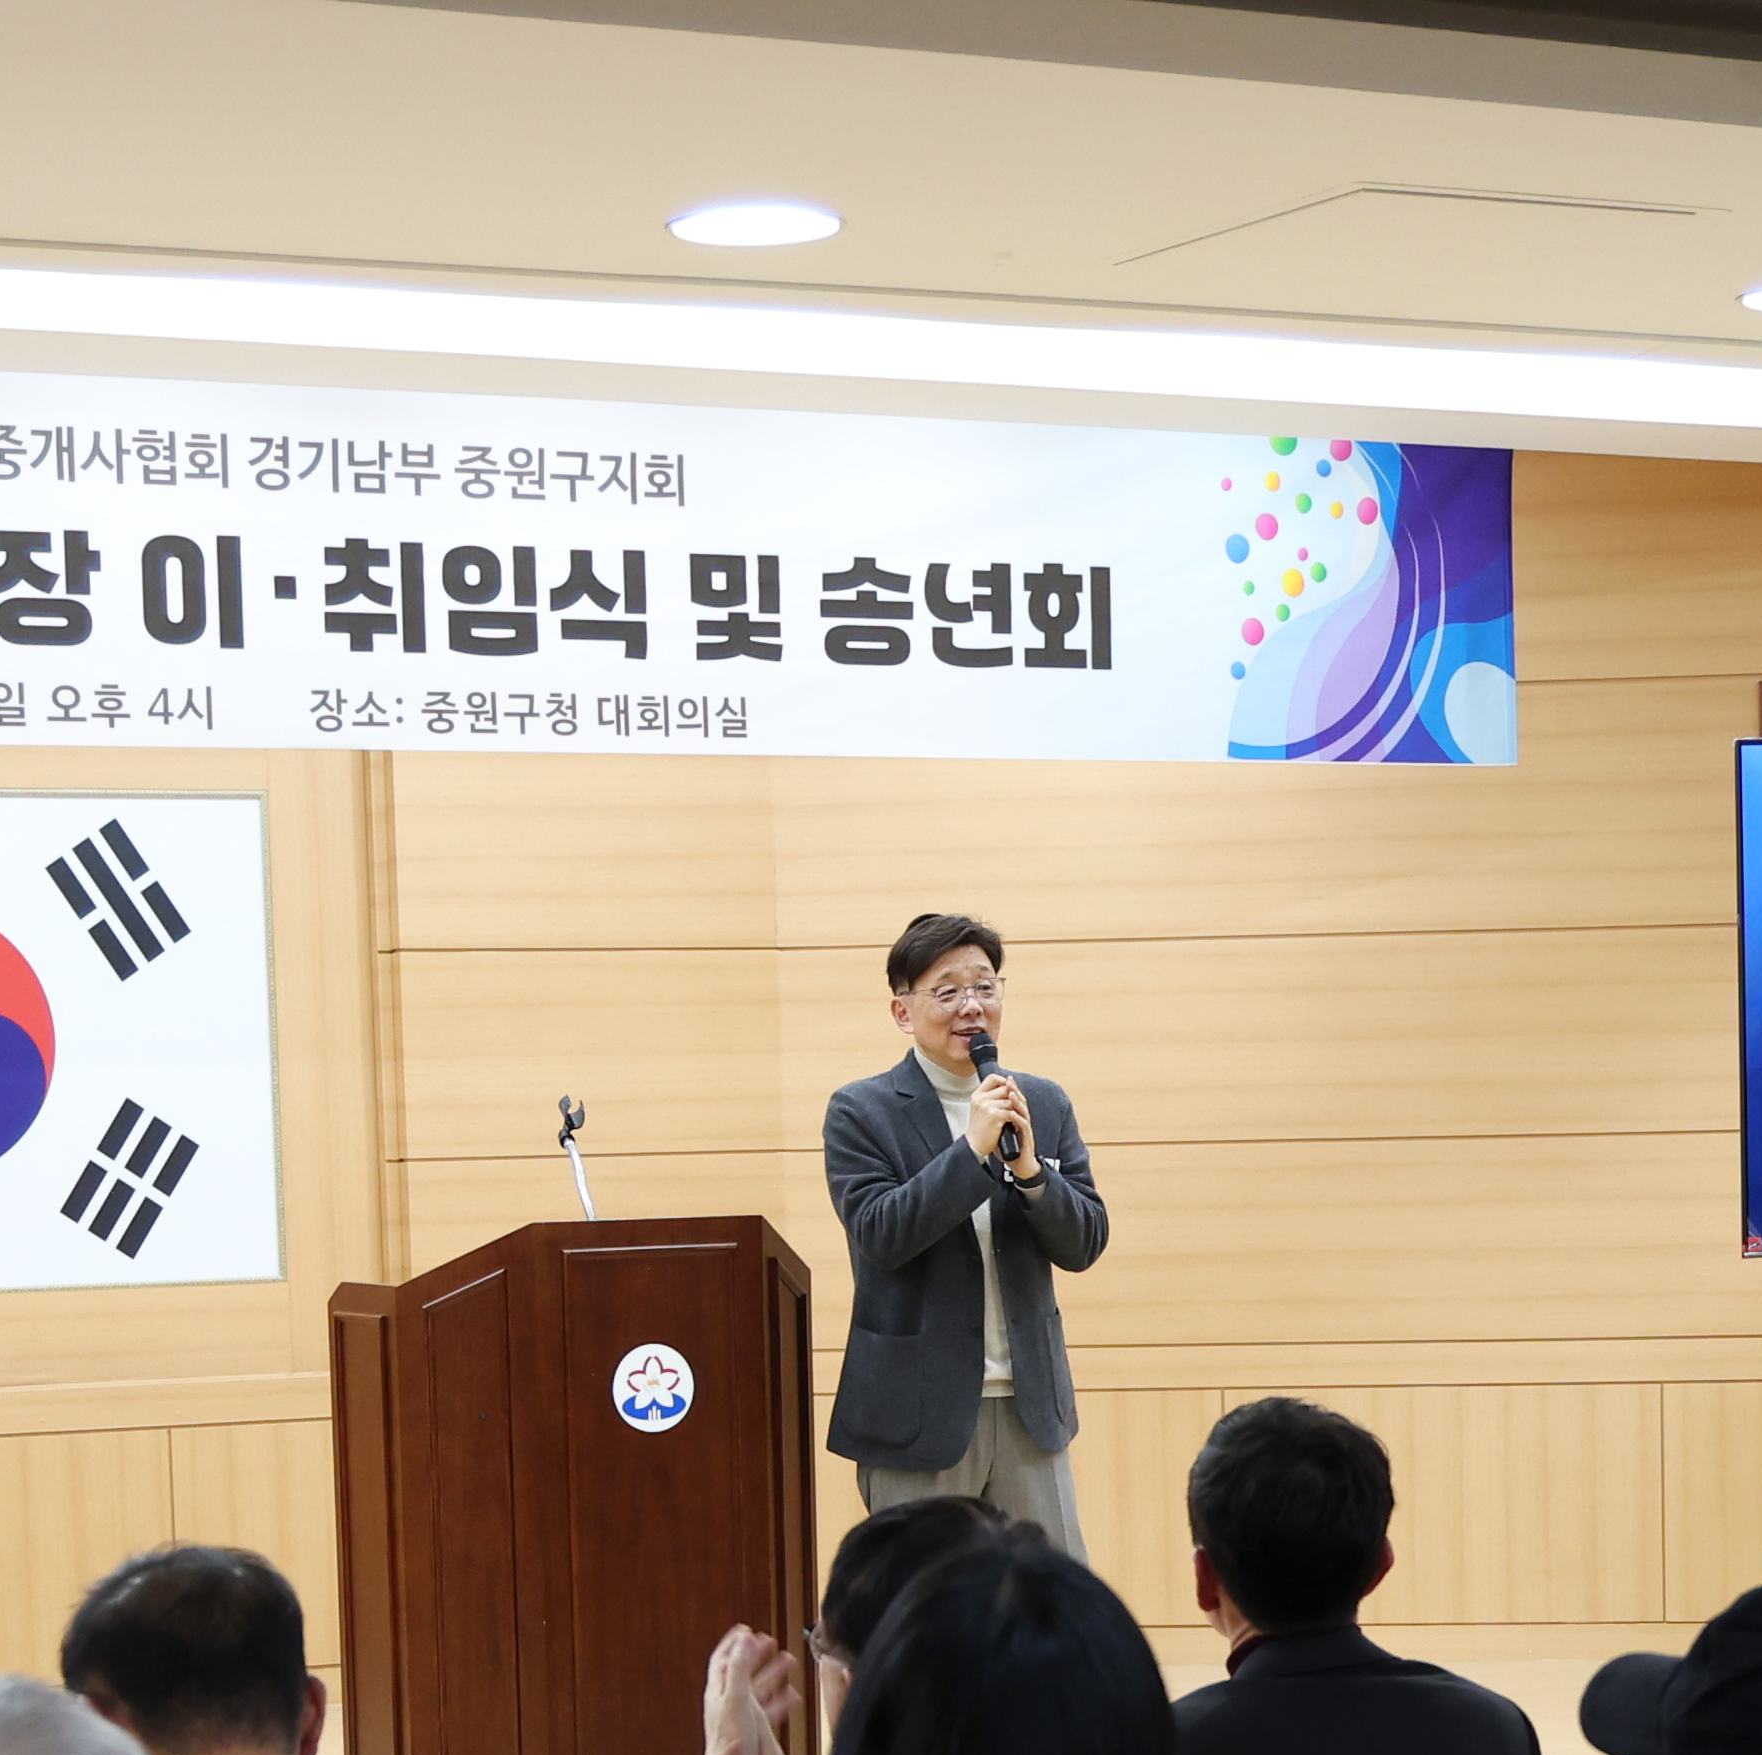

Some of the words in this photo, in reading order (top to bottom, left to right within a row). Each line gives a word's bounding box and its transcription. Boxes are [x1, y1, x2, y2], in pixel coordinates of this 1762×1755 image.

[249, 436, 440, 496] 경기남부
[455, 446, 684, 506] 중원구지회
[690, 554, 783, 661] 및
[820, 557, 1112, 670] 송년회
[47, 684, 130, 728] 오후
[148, 686, 212, 730] 4시
[310, 689, 403, 732] 장소:
[422, 692, 577, 735] 중원구청
[598, 695, 747, 738] 대회의실
